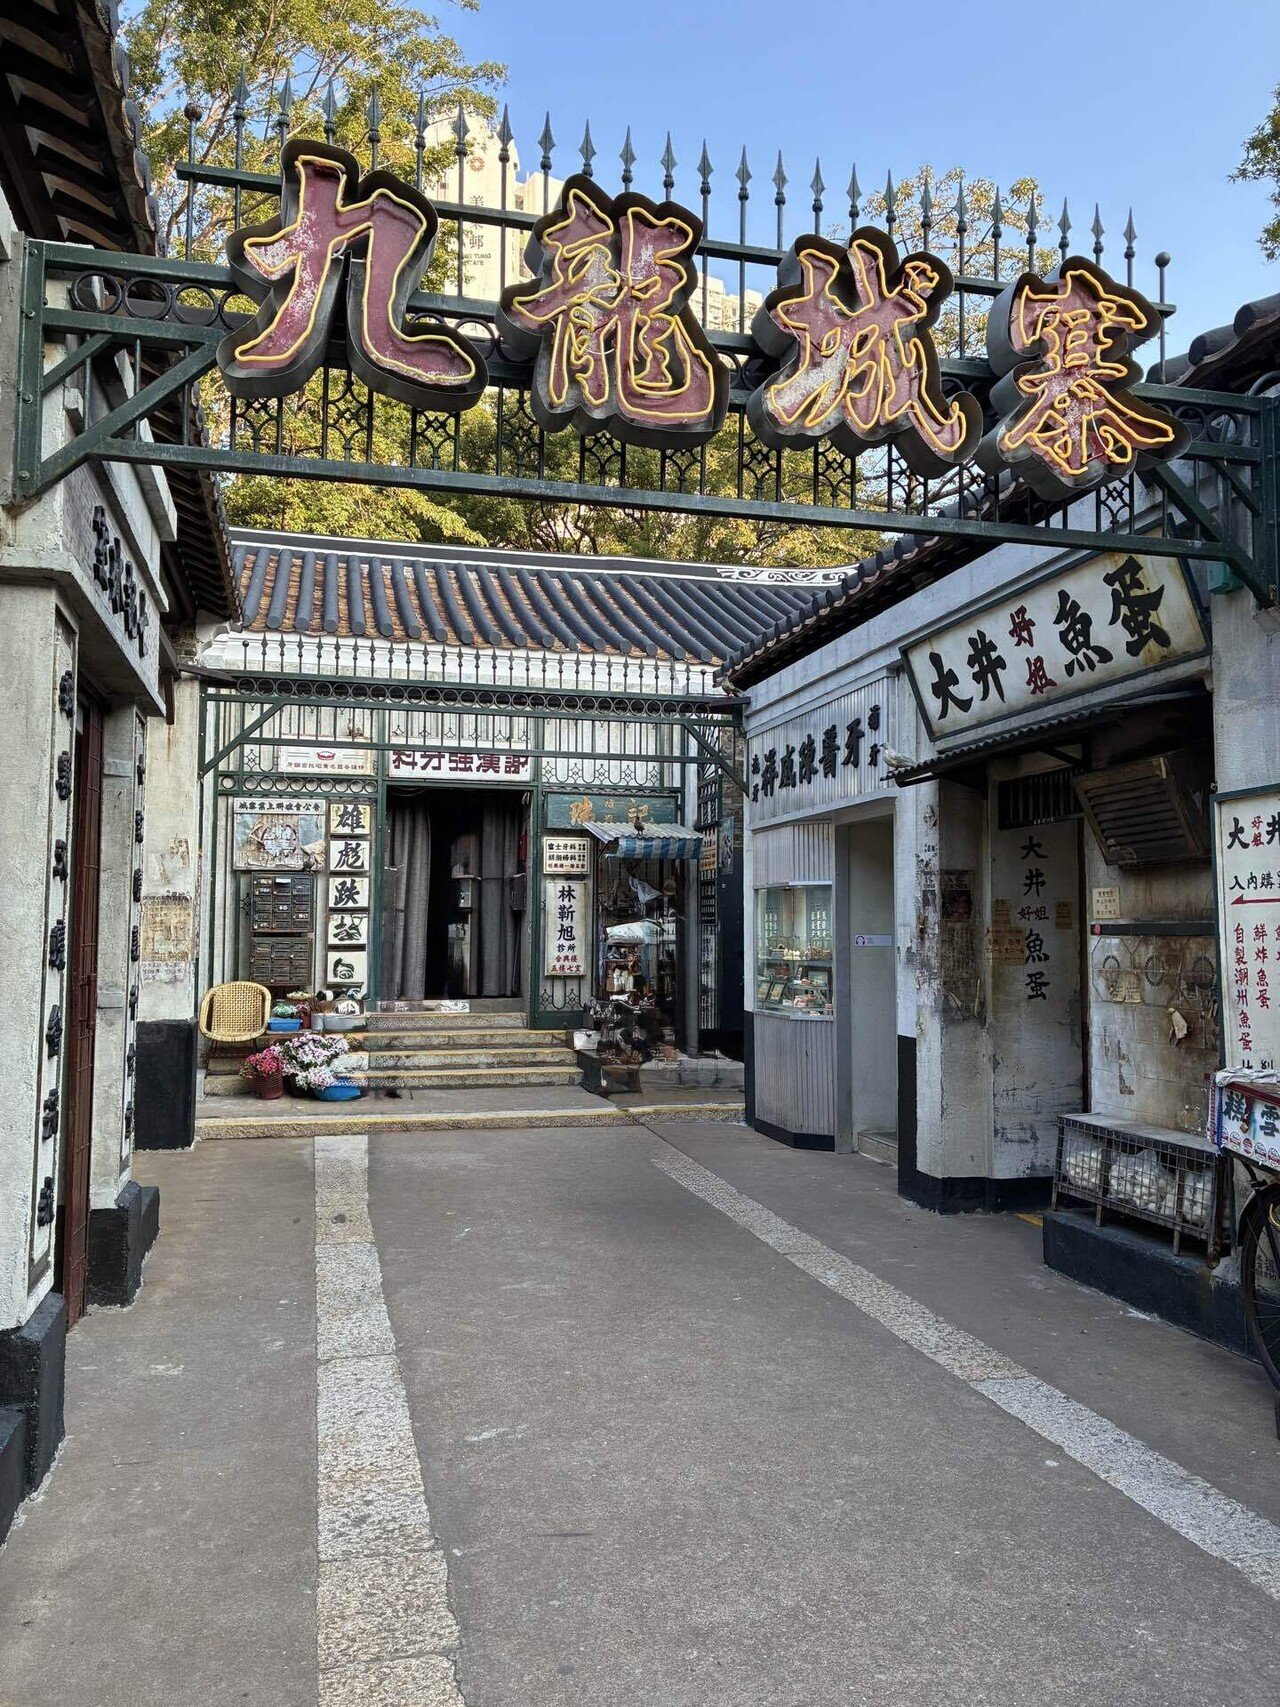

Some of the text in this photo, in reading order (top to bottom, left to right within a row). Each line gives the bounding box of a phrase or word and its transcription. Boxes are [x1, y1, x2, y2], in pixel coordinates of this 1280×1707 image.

[1233, 923, 1253, 1052] 自製潮州魚蛋
[1253, 924, 1271, 1010] 鮮炸魚蛋
